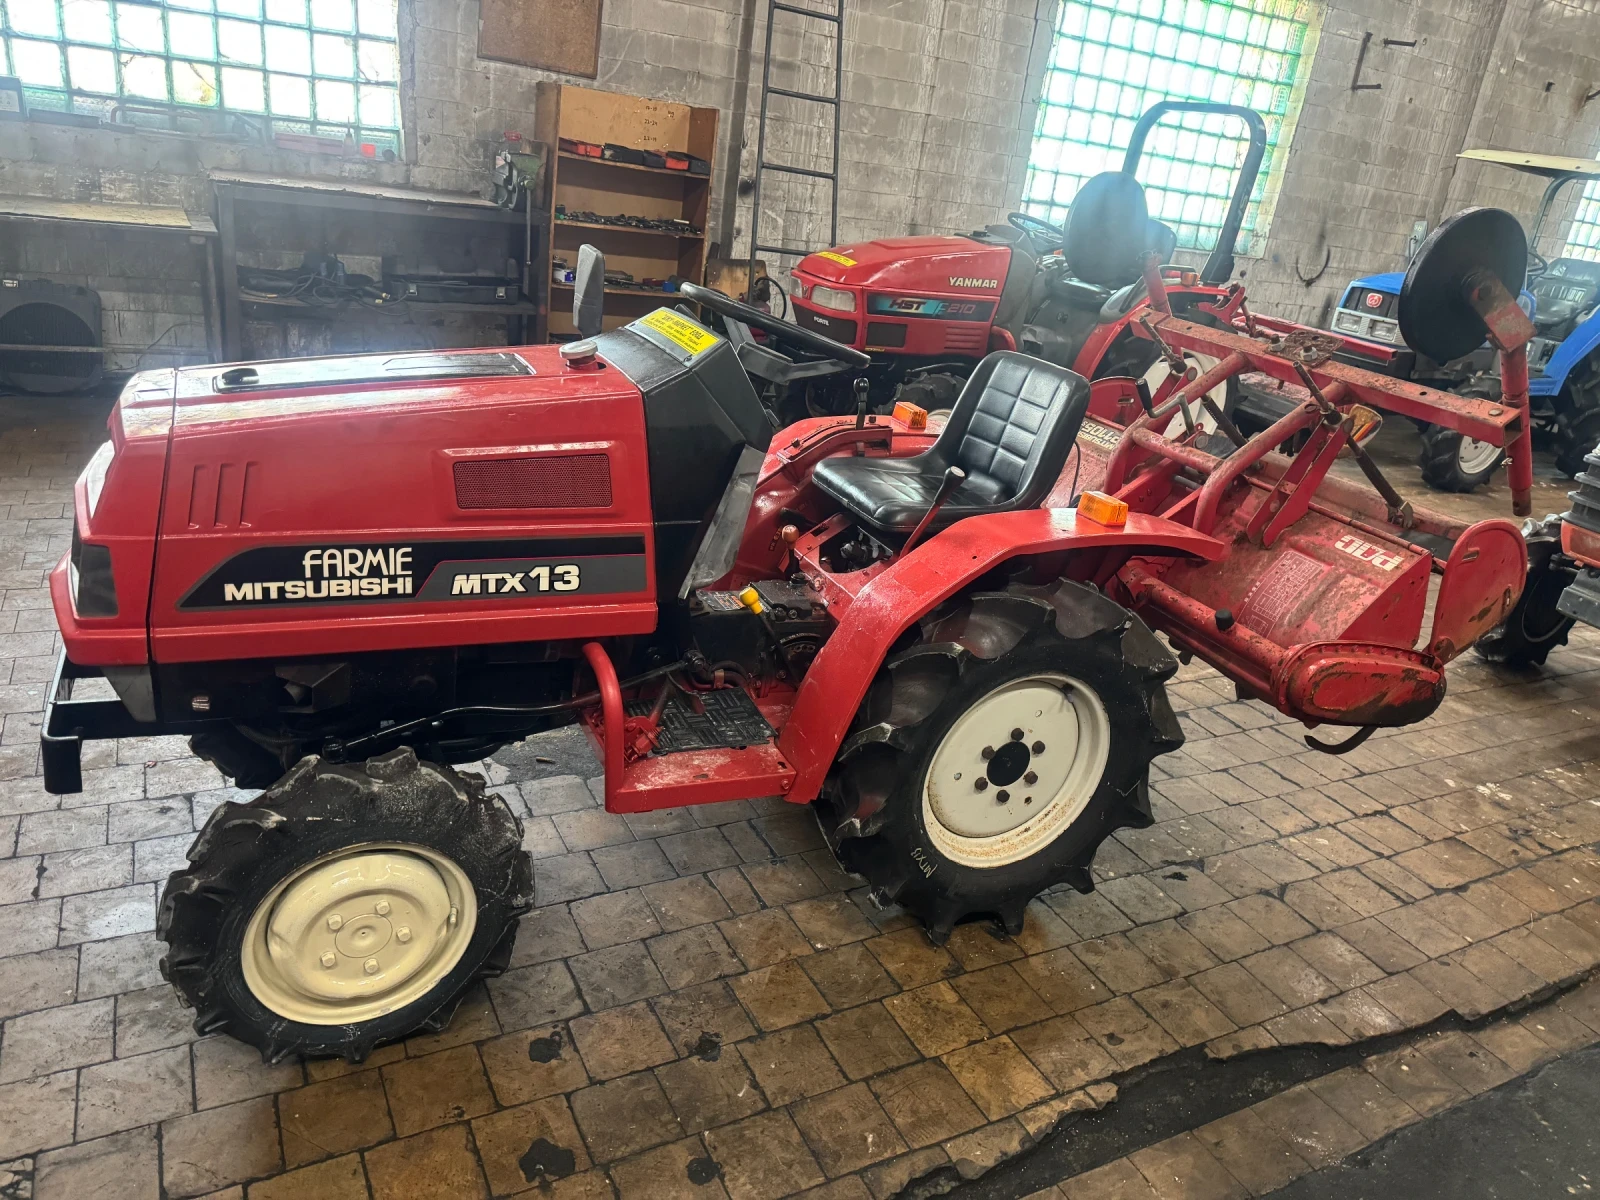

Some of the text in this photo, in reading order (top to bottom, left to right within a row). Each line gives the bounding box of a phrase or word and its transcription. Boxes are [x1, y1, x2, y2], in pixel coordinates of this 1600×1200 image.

[948, 276, 998, 289] YANMAR
[888, 298, 928, 311] HST
[302, 547, 413, 578] FARMIE
[223, 576, 413, 601] MITSUBISHI
